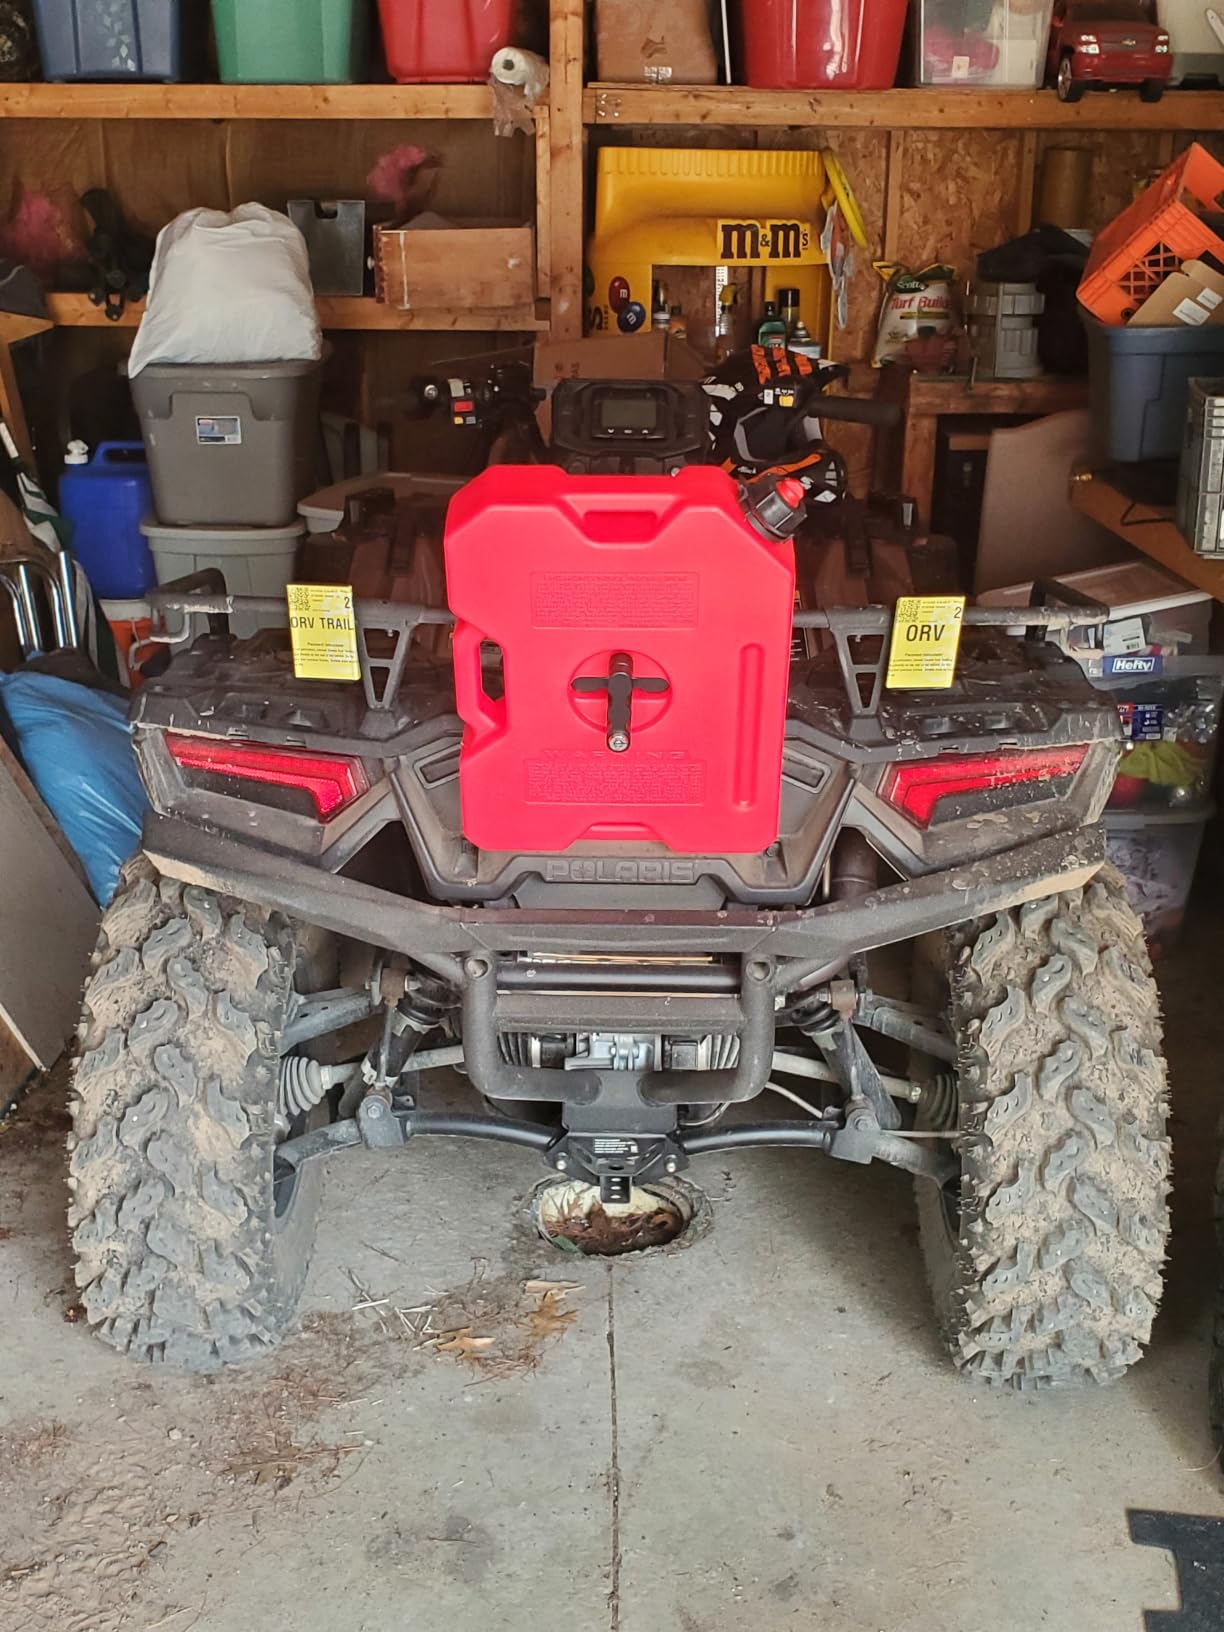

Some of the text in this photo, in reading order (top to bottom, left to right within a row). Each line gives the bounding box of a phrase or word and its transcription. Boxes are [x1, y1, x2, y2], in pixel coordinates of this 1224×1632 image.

[343, 596, 351, 609] 2
[953, 606, 962, 619] 2
[290, 616, 354, 630] ORV TRAIL
[906, 624, 945, 642] ORV
[1115, 659, 1152, 671] Hefty
[546, 860, 695, 882] POLARIS
